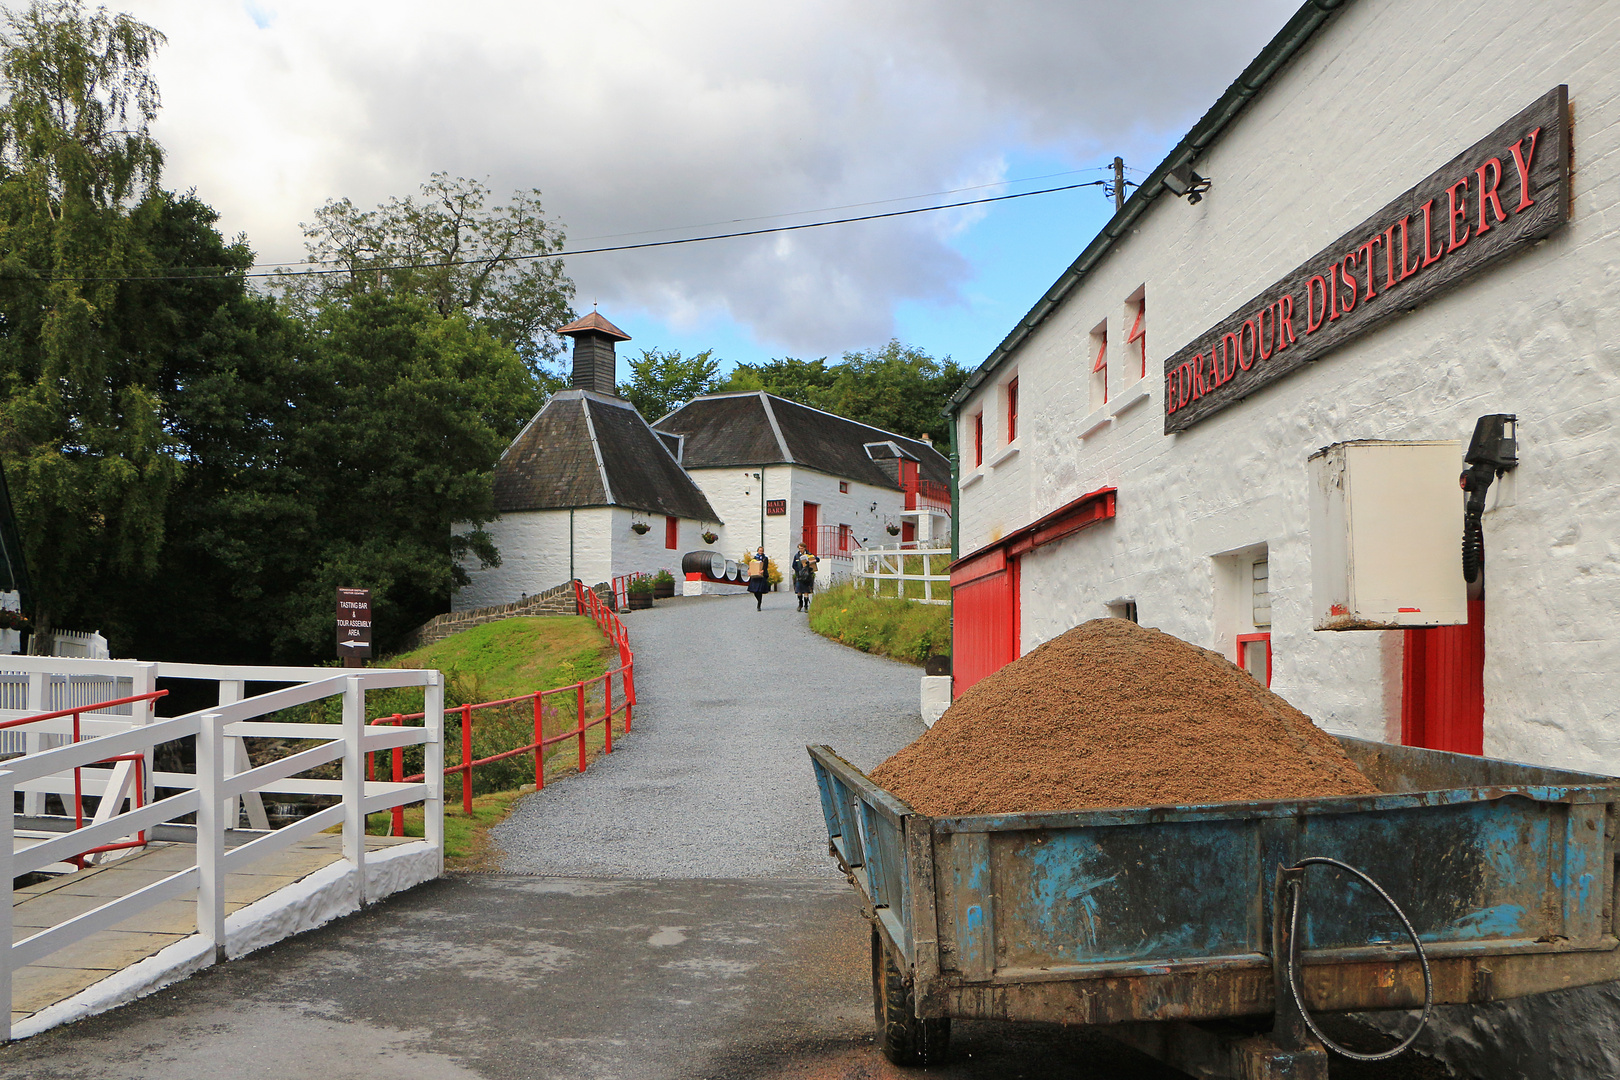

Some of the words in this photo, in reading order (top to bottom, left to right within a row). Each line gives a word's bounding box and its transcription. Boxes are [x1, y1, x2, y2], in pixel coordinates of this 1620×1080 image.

[1166, 293, 1296, 415] EDRADOUR
[1305, 127, 1541, 335] DISTILLERY
[340, 601, 358, 609] TASTING
